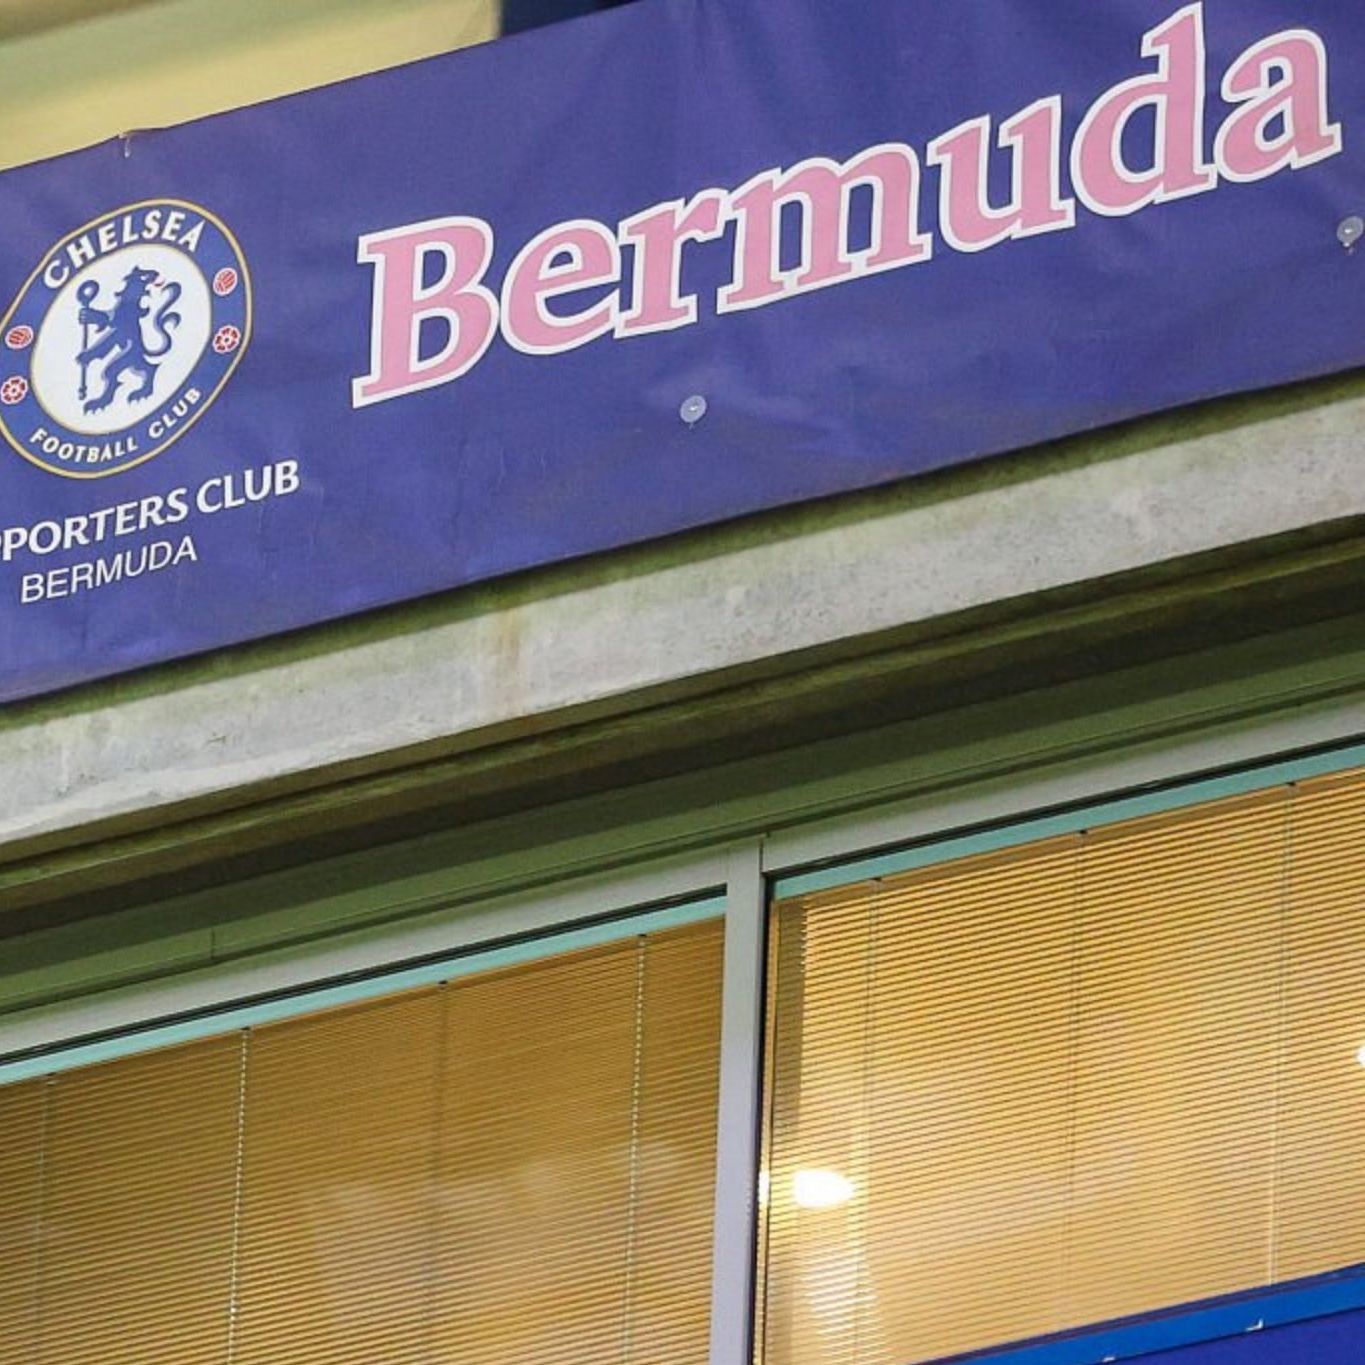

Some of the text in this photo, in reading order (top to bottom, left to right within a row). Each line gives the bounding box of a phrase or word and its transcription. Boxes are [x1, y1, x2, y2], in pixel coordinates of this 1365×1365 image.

[352, 1, 1343, 409] Bermuda
[43, 209, 206, 290] CHELSEA
[29, 387, 202, 463] FOOTBALL CLUB
[195, 459, 301, 515] CLUB
[20, 534, 198, 604] BERMUDA
